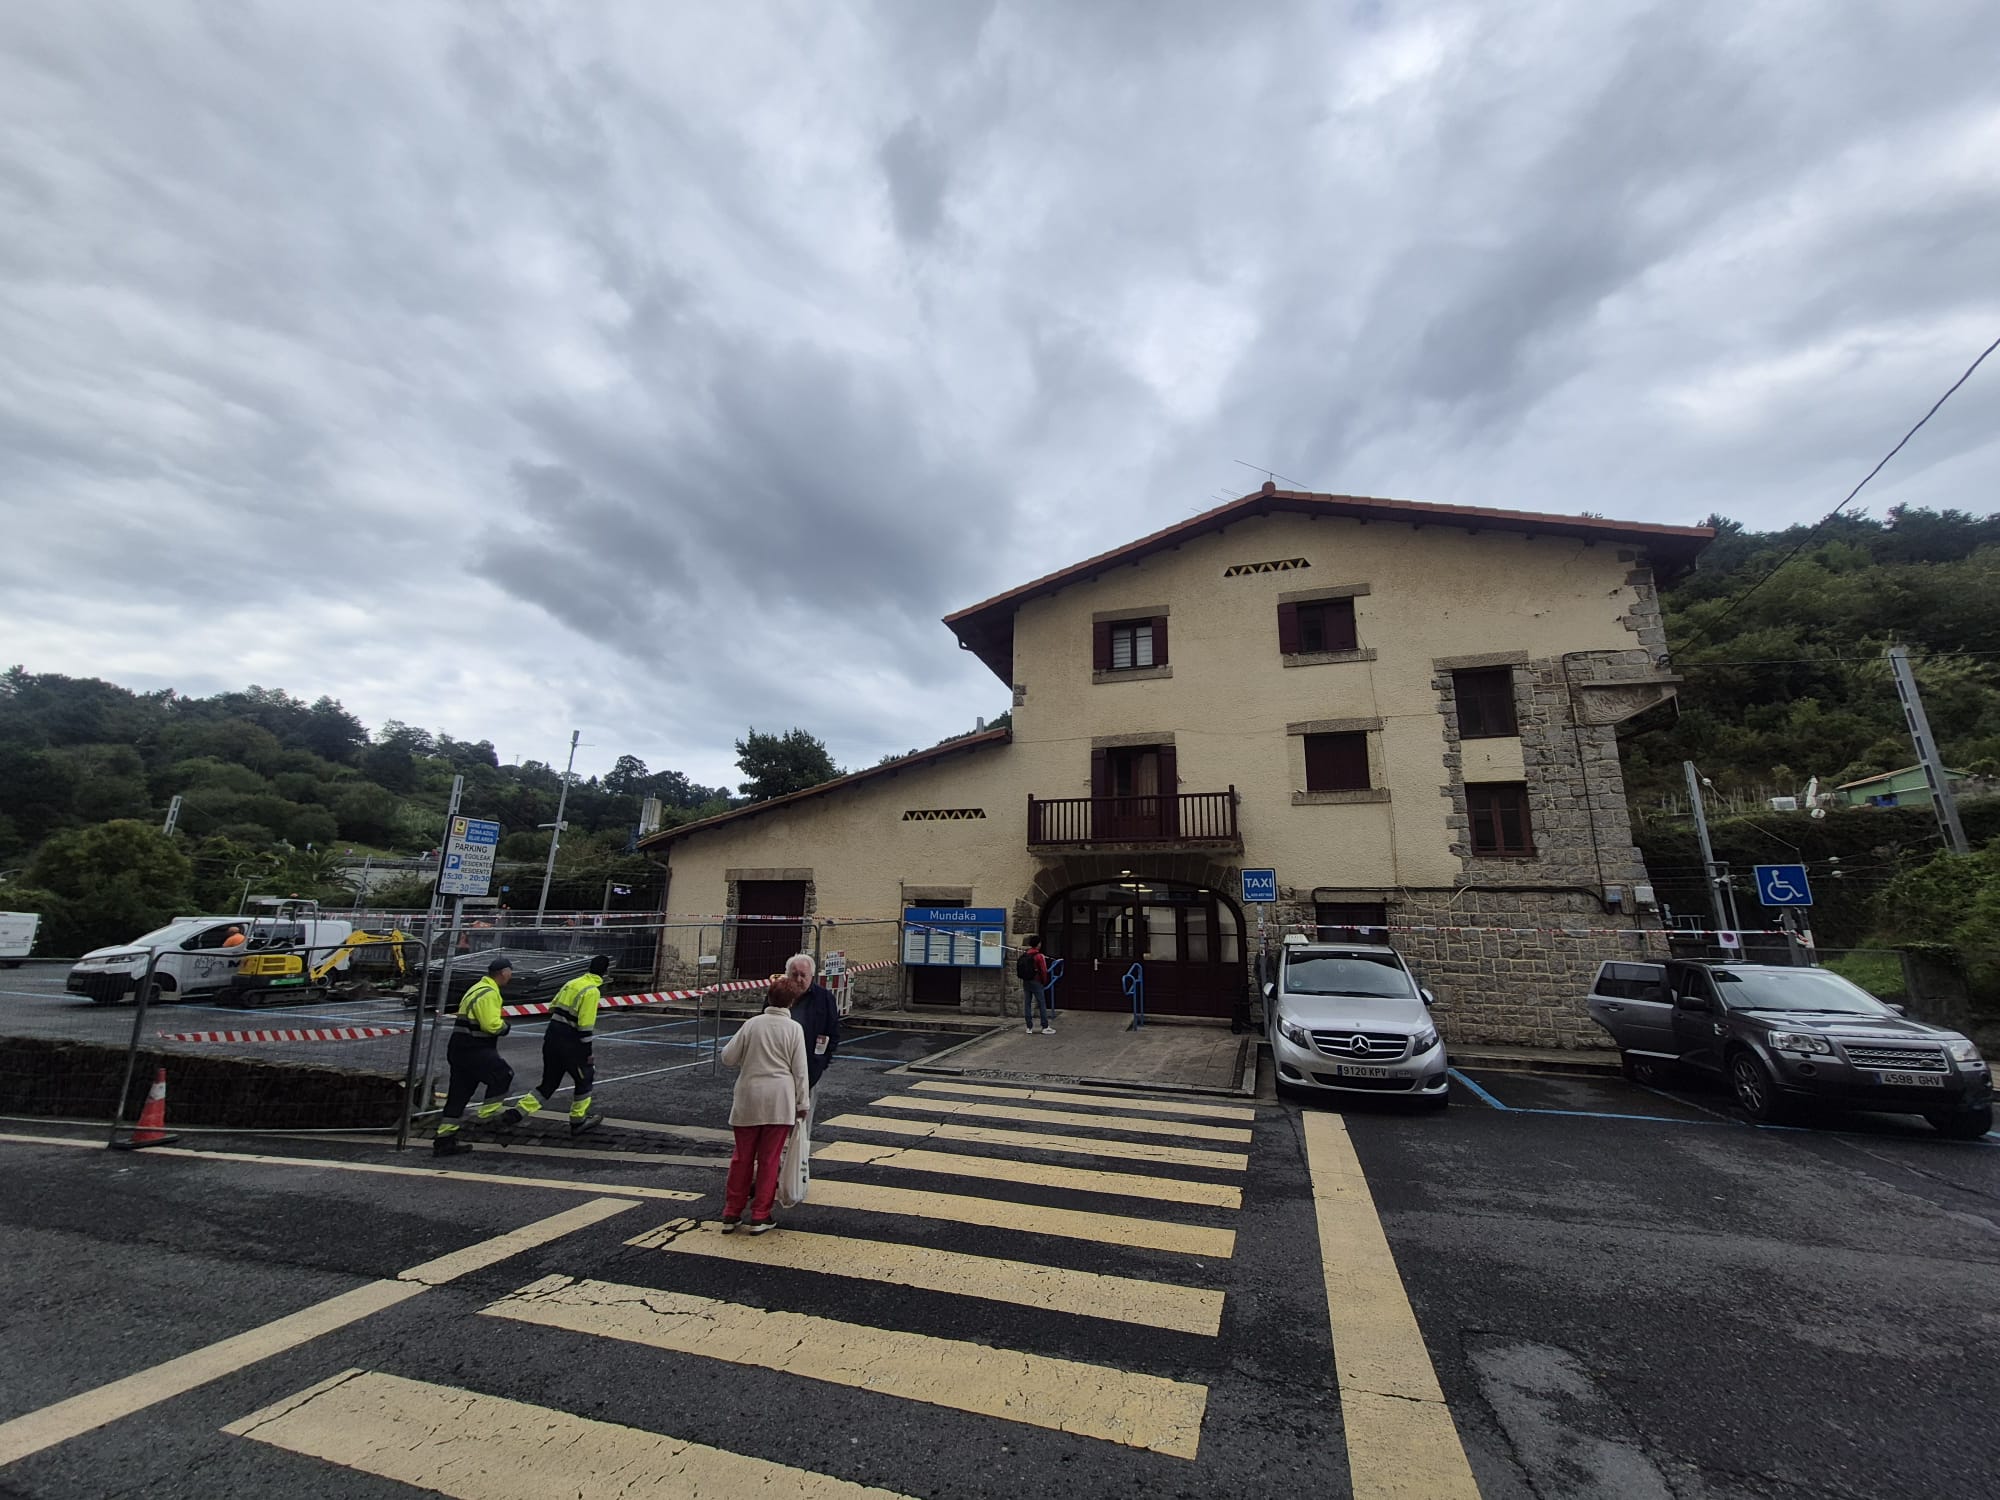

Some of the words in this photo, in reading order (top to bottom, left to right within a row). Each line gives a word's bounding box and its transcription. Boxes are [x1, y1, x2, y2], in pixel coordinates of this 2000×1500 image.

[455, 843, 488, 853] PARKING
[447, 855, 459, 867] P
[461, 860, 493, 869] RESIDENTES
[461, 867, 490, 875] RESIDENTS
[444, 872, 463, 880] 15:30
[469, 874, 490, 882] 20:30
[460, 883, 470, 892] 30
[1245, 878, 1273, 888] TAXI
[929, 910, 977, 921] Mundaka
[1343, 1066, 1367, 1076] 9120
[1369, 1067, 1387, 1077] KPV
[1885, 1073, 1914, 1084] 4598
